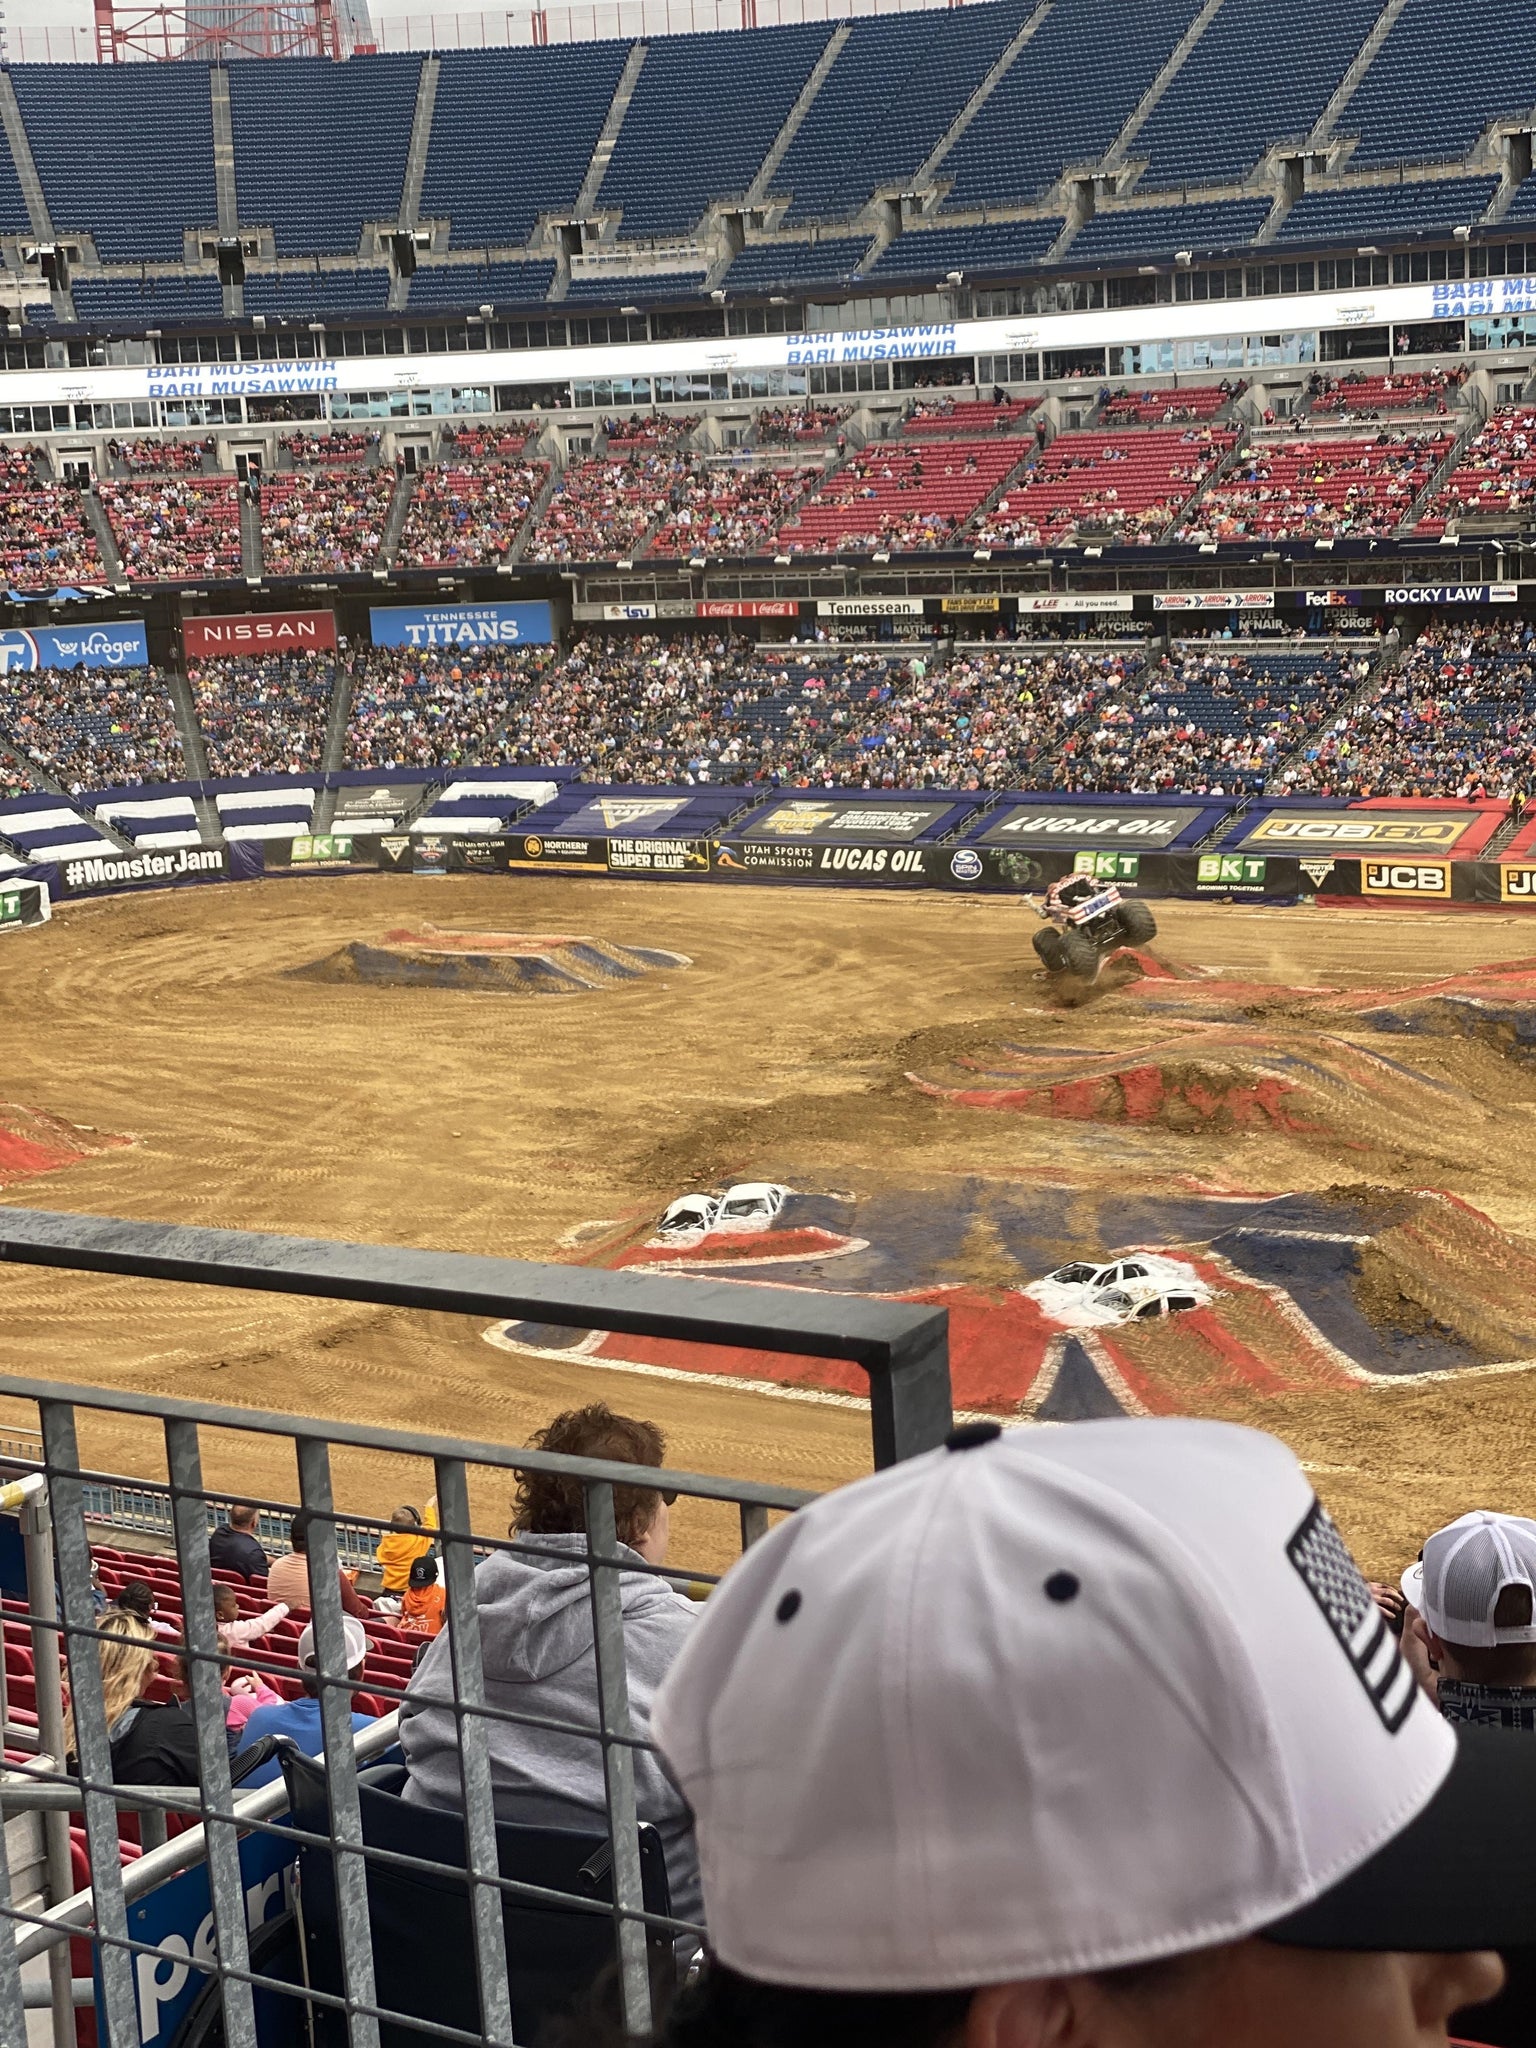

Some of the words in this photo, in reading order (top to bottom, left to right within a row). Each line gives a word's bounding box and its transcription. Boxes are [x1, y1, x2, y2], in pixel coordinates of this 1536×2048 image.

[787, 348, 836, 365] BARI
[843, 340, 957, 362] MUSAWWIR
[148, 382, 203, 397] BARI
[211, 377, 338, 395] MUSAWWIR
[1165, 597, 1187, 605] ARROW
[1205, 596, 1226, 604] ARROW
[1245, 595, 1267, 603] ARROW
[1305, 590, 1348, 606] FedEx
[1385, 588, 1443, 604] ROCKY
[1446, 586, 1483, 602] LAW
[1042, 599, 1060, 607] LEE
[1100, 600, 1120, 608] need.
[624, 606, 650, 619] tsu
[708, 604, 735, 616] Coca-Cola
[758, 604, 786, 616] Coca-Cola
[1239, 609, 1275, 619] STEVE
[1324, 608, 1359, 618] EDDIE
[424, 611, 498, 622] TENNESSEE
[892, 615, 927, 625] BRUCE
[1094, 612, 1133, 622] FRANK
[203, 620, 317, 641] NISSAN
[405, 620, 521, 645] TITANS
[893, 624, 950, 636] MATTHES
[1016, 623, 1049, 634] MON
[1096, 621, 1149, 632] WYCHEC
[81, 632, 141, 664] Kroger
[1001, 817, 1120, 835] LUCAS
[1266, 822, 1376, 839] JCB
[292, 837, 353, 857] BKT
[543, 841, 588, 850] NORTHERN
[611, 839, 634, 852] THE
[635, 840, 691, 855] ORIGINAL
[743, 845, 771, 855] UTAH
[774, 846, 814, 857] SPORTS
[611, 852, 651, 867] SUPER
[654, 855, 685, 869] GLUE
[744, 856, 813, 868] COMMISSION
[820, 848, 888, 871] LUCAS
[1075, 855, 1139, 875] BKT
[66, 850, 224, 887] #MonsterJam
[1198, 859, 1265, 878] BKT
[1367, 866, 1444, 890] JCB
[1508, 871, 1536, 895] J
[1229, 884, 1265, 892] TOGETHER
